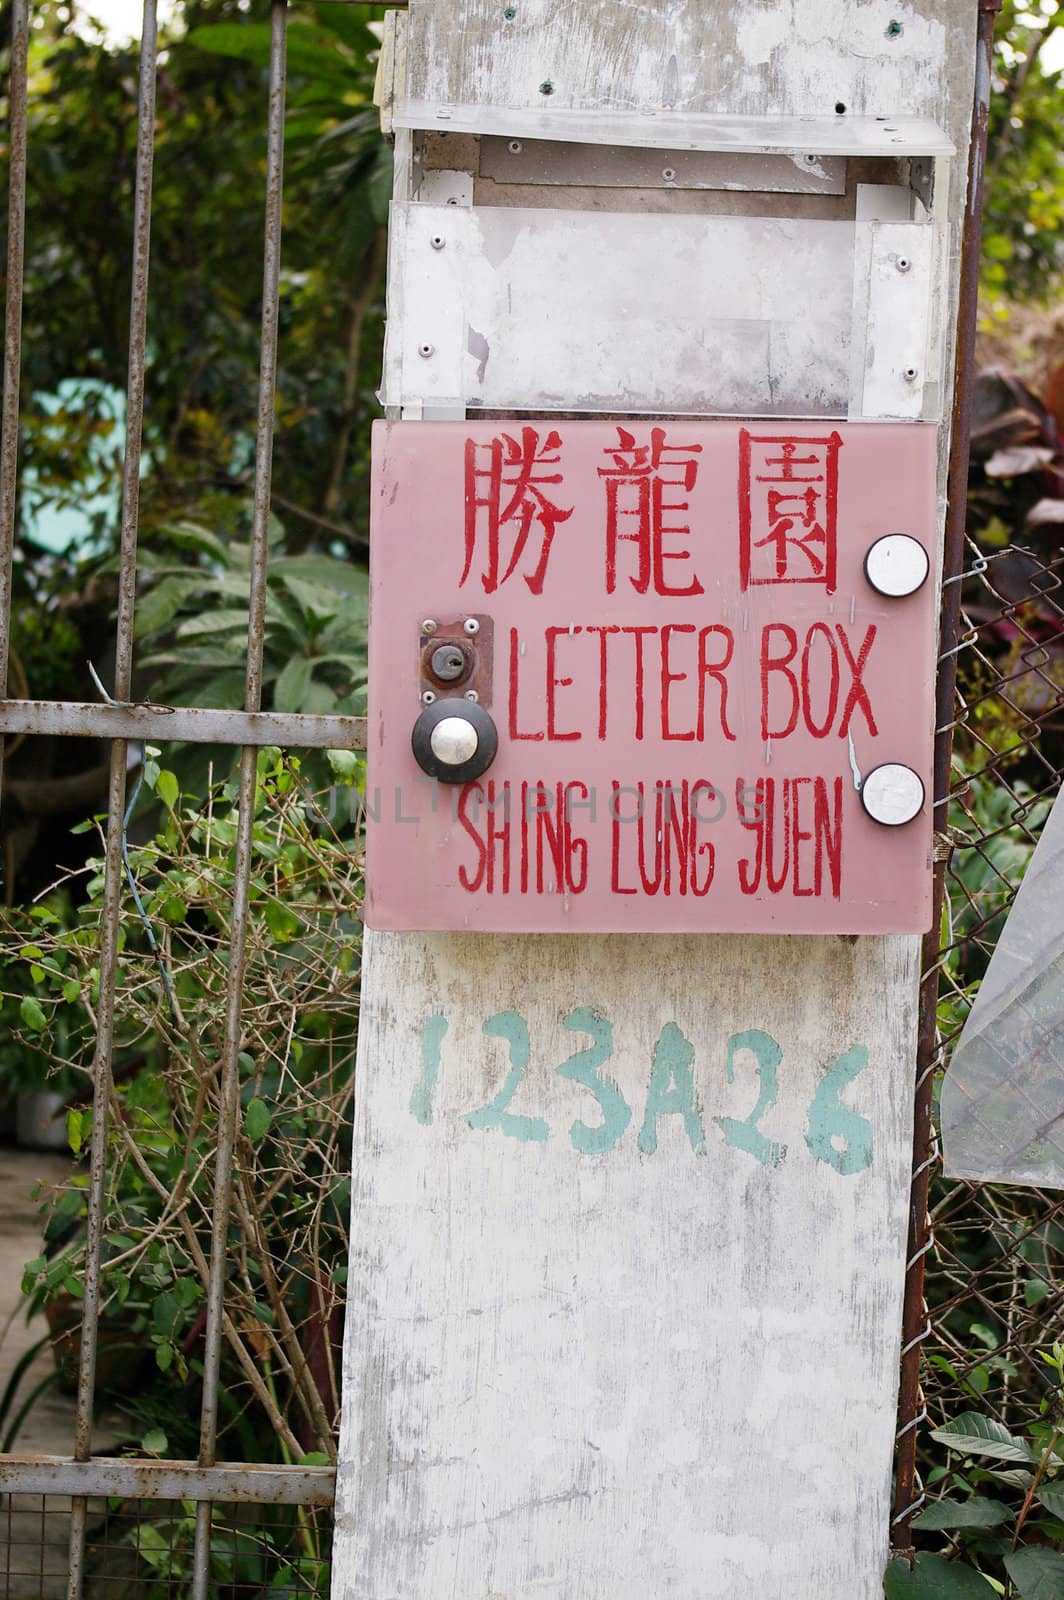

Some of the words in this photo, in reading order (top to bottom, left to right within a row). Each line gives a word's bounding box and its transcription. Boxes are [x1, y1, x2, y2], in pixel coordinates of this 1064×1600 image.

[458, 425, 845, 596] 勝龍園
[509, 623, 736, 743] LETTER
[760, 620, 880, 742] BOX
[457, 779, 589, 895] SHING
[611, 778, 716, 897] LUNG
[736, 775, 844, 900] YUEN
[410, 1005, 875, 1175] 123A26
